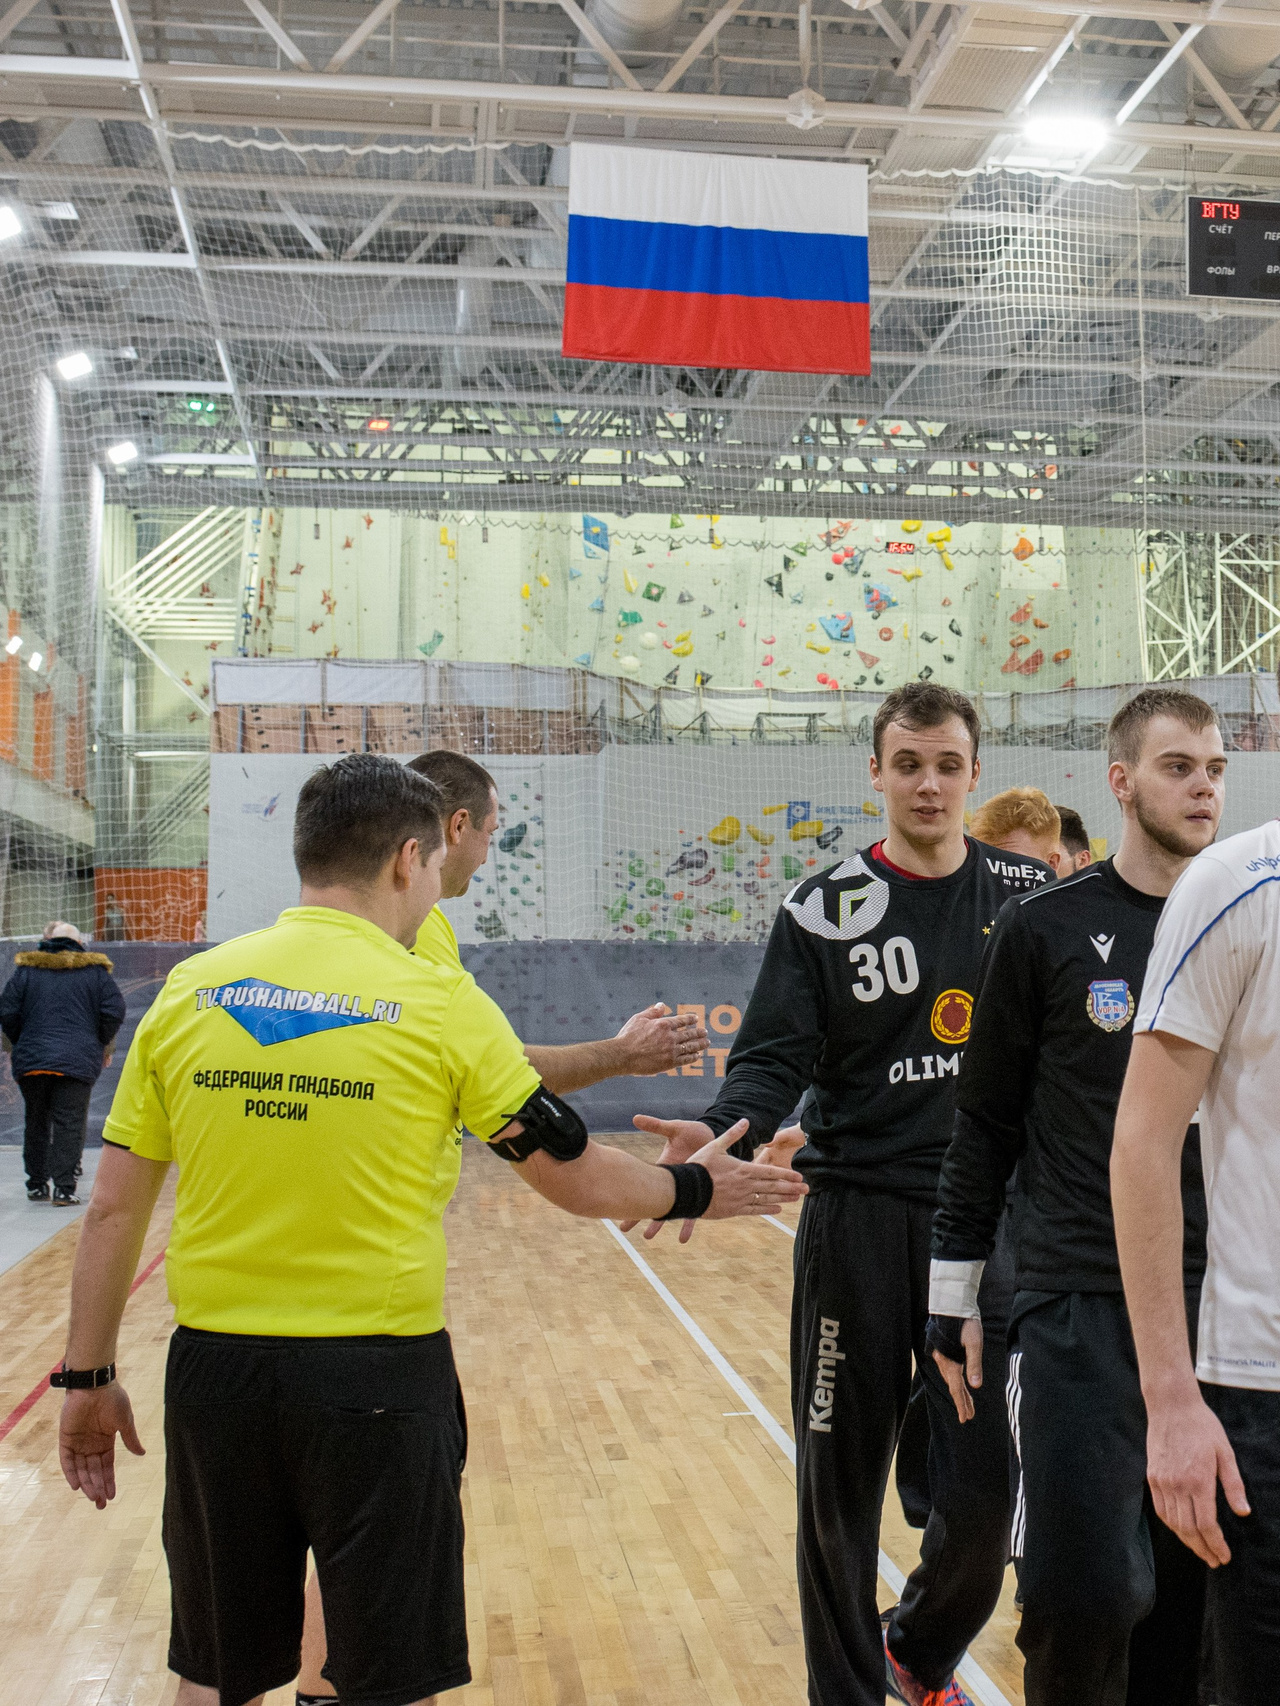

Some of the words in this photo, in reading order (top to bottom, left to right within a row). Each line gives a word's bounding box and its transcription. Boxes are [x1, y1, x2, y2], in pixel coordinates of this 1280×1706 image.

[1202, 202, 1240, 220] ВГТУ
[1206, 266, 1236, 276] ФОЛЫ
[986, 858, 1046, 883] VinEx
[1003, 879, 1043, 889] medi
[849, 936, 920, 1002] 30
[196, 986, 402, 1024] TV.RUSHANDBALL.RU
[889, 1051, 964, 1084] OLIM
[193, 1070, 284, 1093] ФЕДЕРАЦИЯ
[288, 1074, 375, 1100] ГАНДБОЛА
[245, 1099, 309, 1121] РОССИИ
[809, 1316, 846, 1433] Kempa
